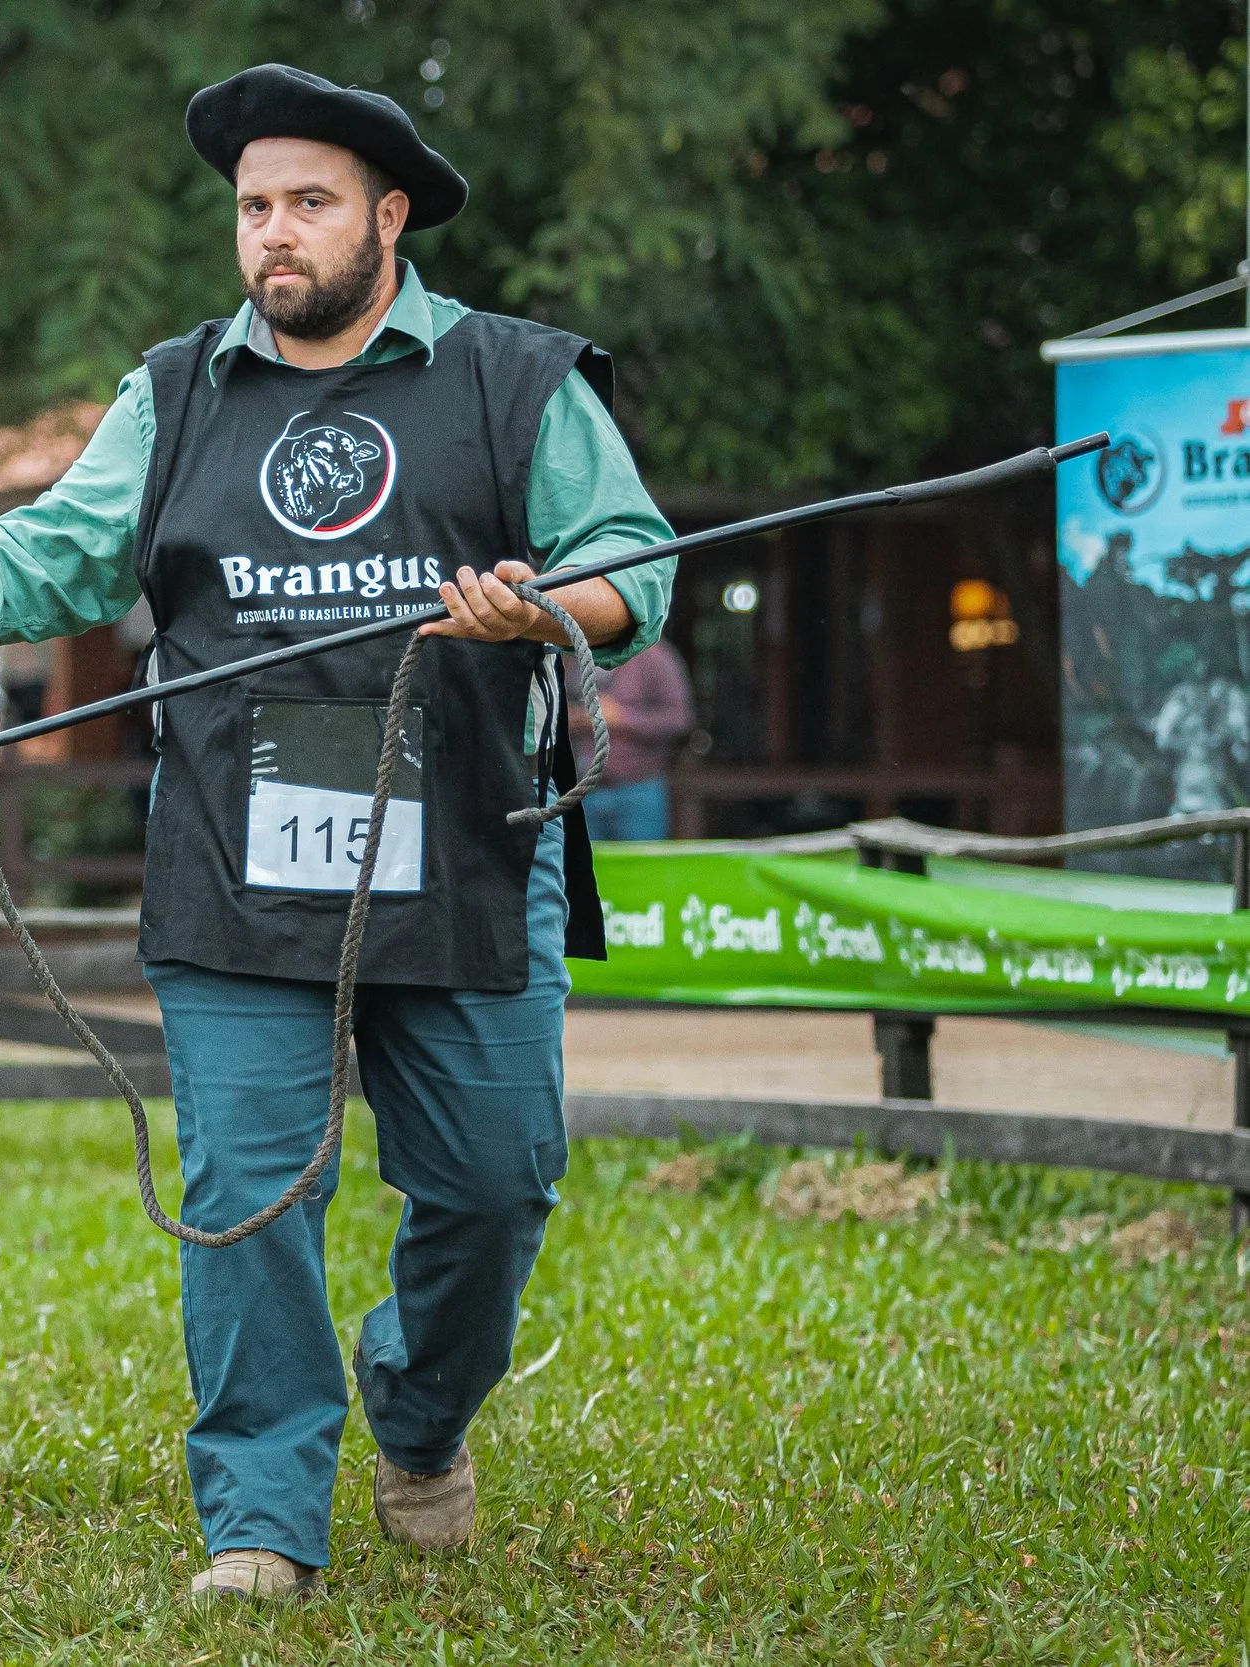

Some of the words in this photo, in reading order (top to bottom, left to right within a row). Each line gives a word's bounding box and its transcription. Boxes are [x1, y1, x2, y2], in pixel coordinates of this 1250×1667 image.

[219, 554, 442, 599] Brangus
[236, 606, 295, 625] ASSOCIAÇÃO
[299, 605, 372, 622] BRASILEIRA
[375, 605, 391, 618] DE
[279, 815, 373, 864] 115
